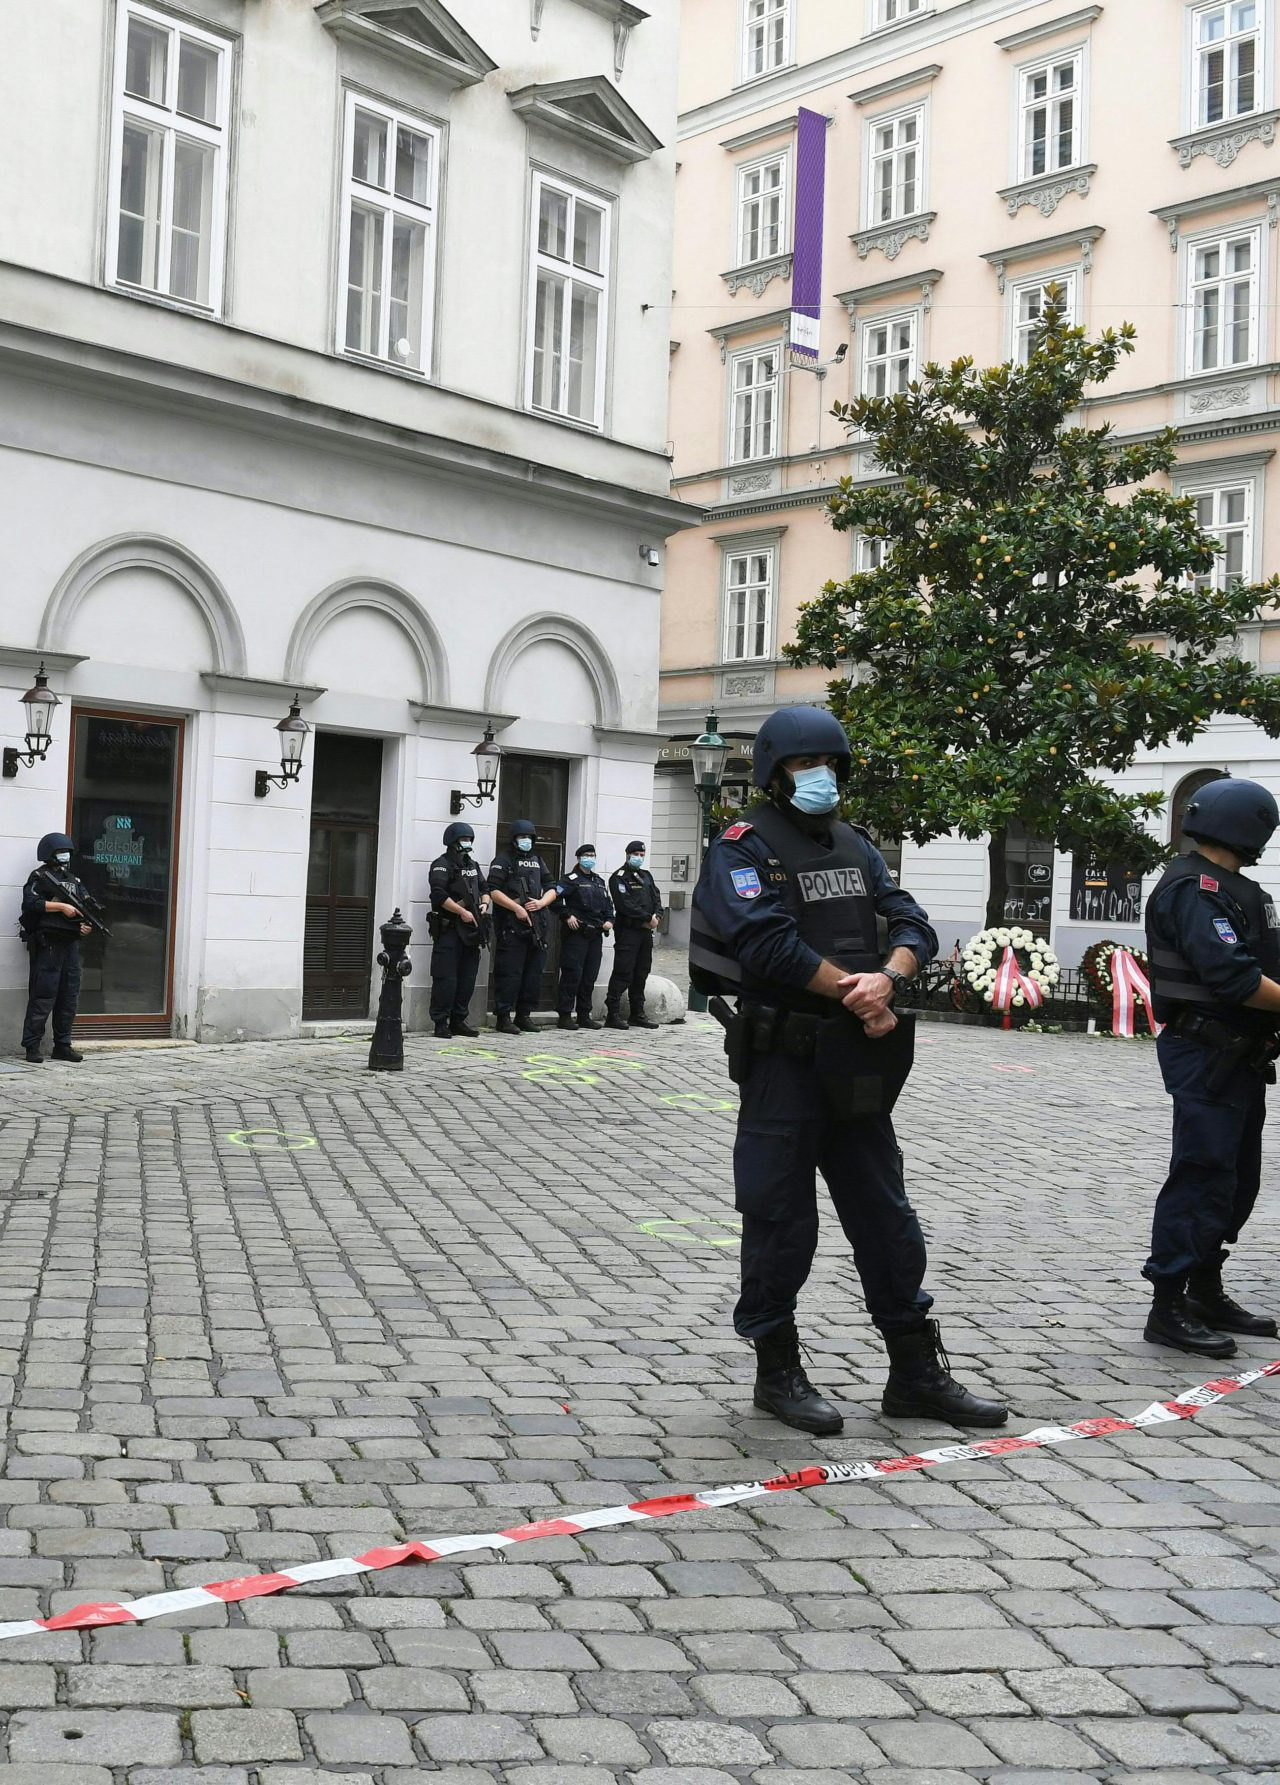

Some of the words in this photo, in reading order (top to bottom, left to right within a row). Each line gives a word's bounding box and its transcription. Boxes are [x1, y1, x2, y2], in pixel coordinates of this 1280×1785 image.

[96, 853, 143, 865] RESTAURANT
[734, 872, 757, 888] BE
[801, 869, 866, 901] POLIZEI
[1215, 922, 1232, 934] BE
